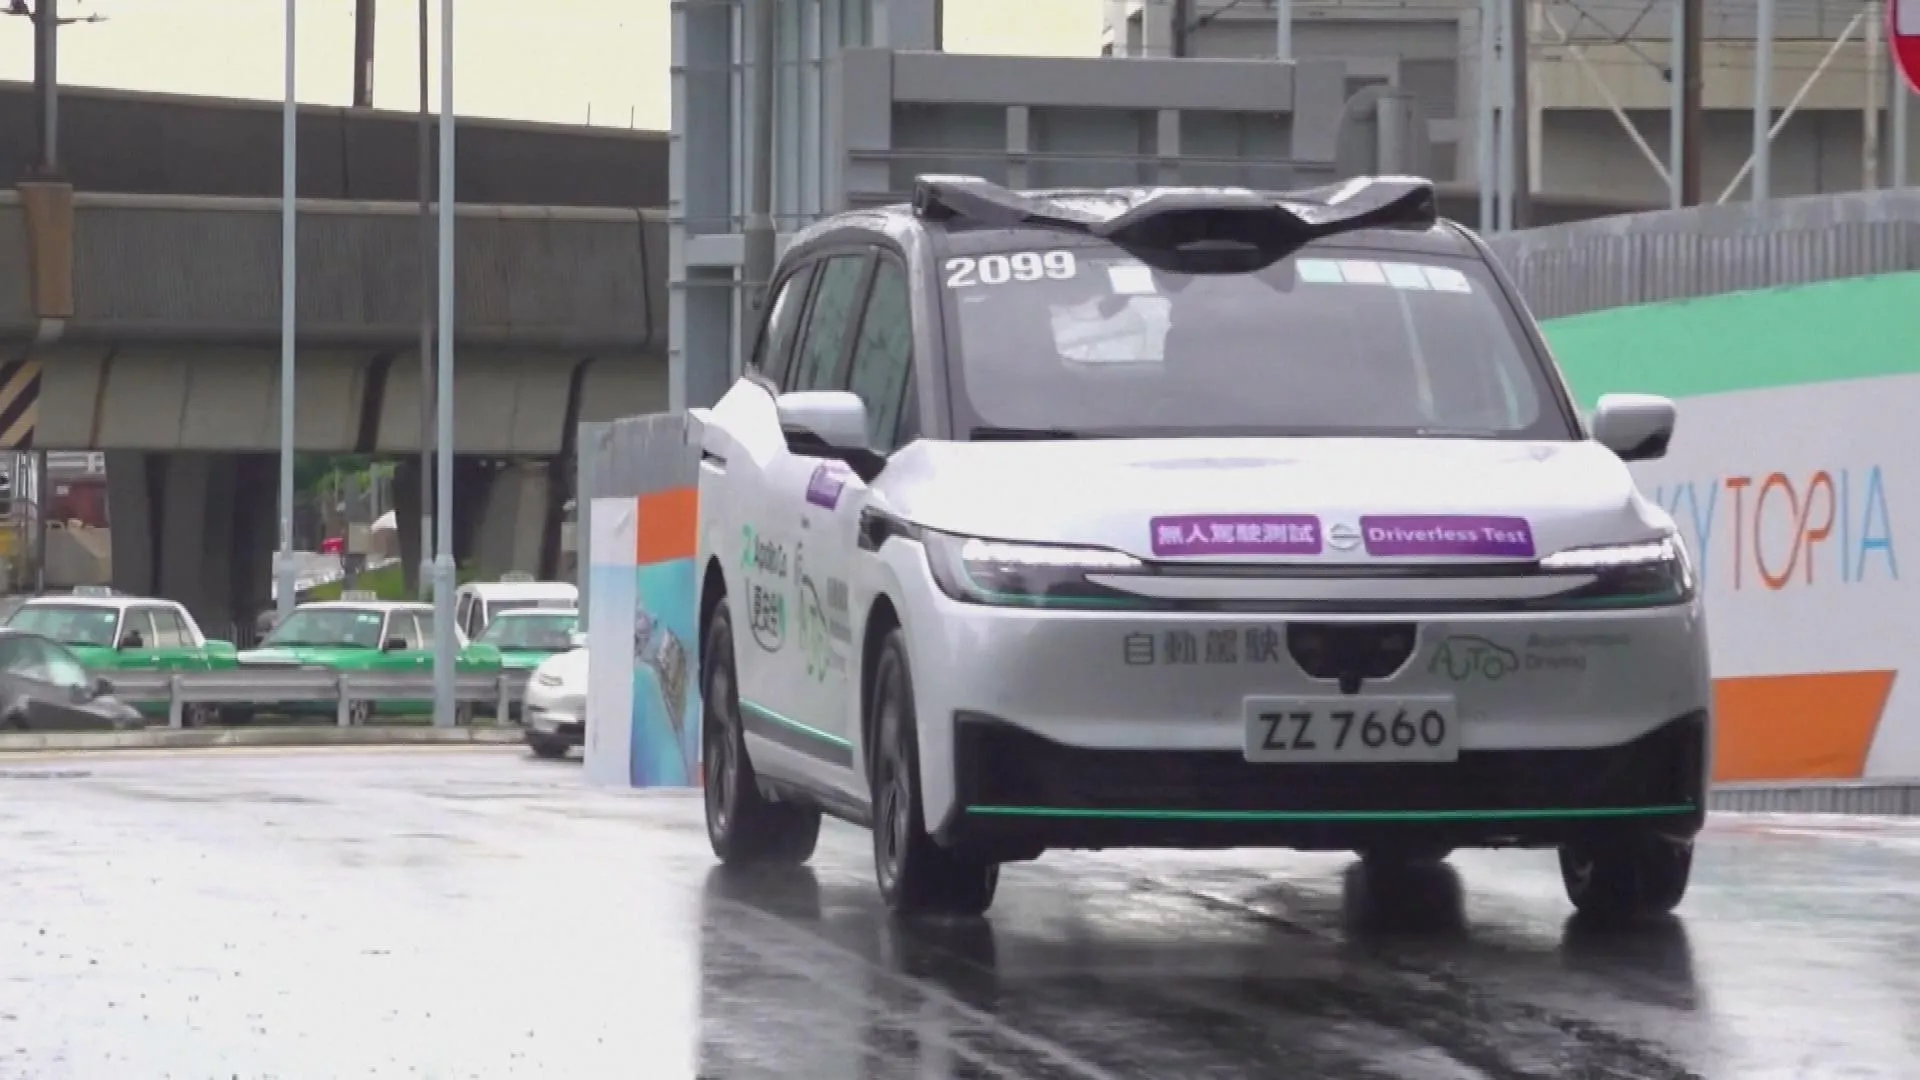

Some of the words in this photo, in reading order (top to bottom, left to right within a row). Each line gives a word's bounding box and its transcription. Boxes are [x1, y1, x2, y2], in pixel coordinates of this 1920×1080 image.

[945, 250, 1077, 288] 2099
[1157, 523, 1315, 545] 無人駕駛測試
[1368, 526, 1478, 543] Driverless
[1482, 527, 1528, 544] Test
[1124, 625, 1279, 665] 自動駕駛
[1258, 712, 1316, 750] ZZ
[1329, 709, 1446, 750] 7660
